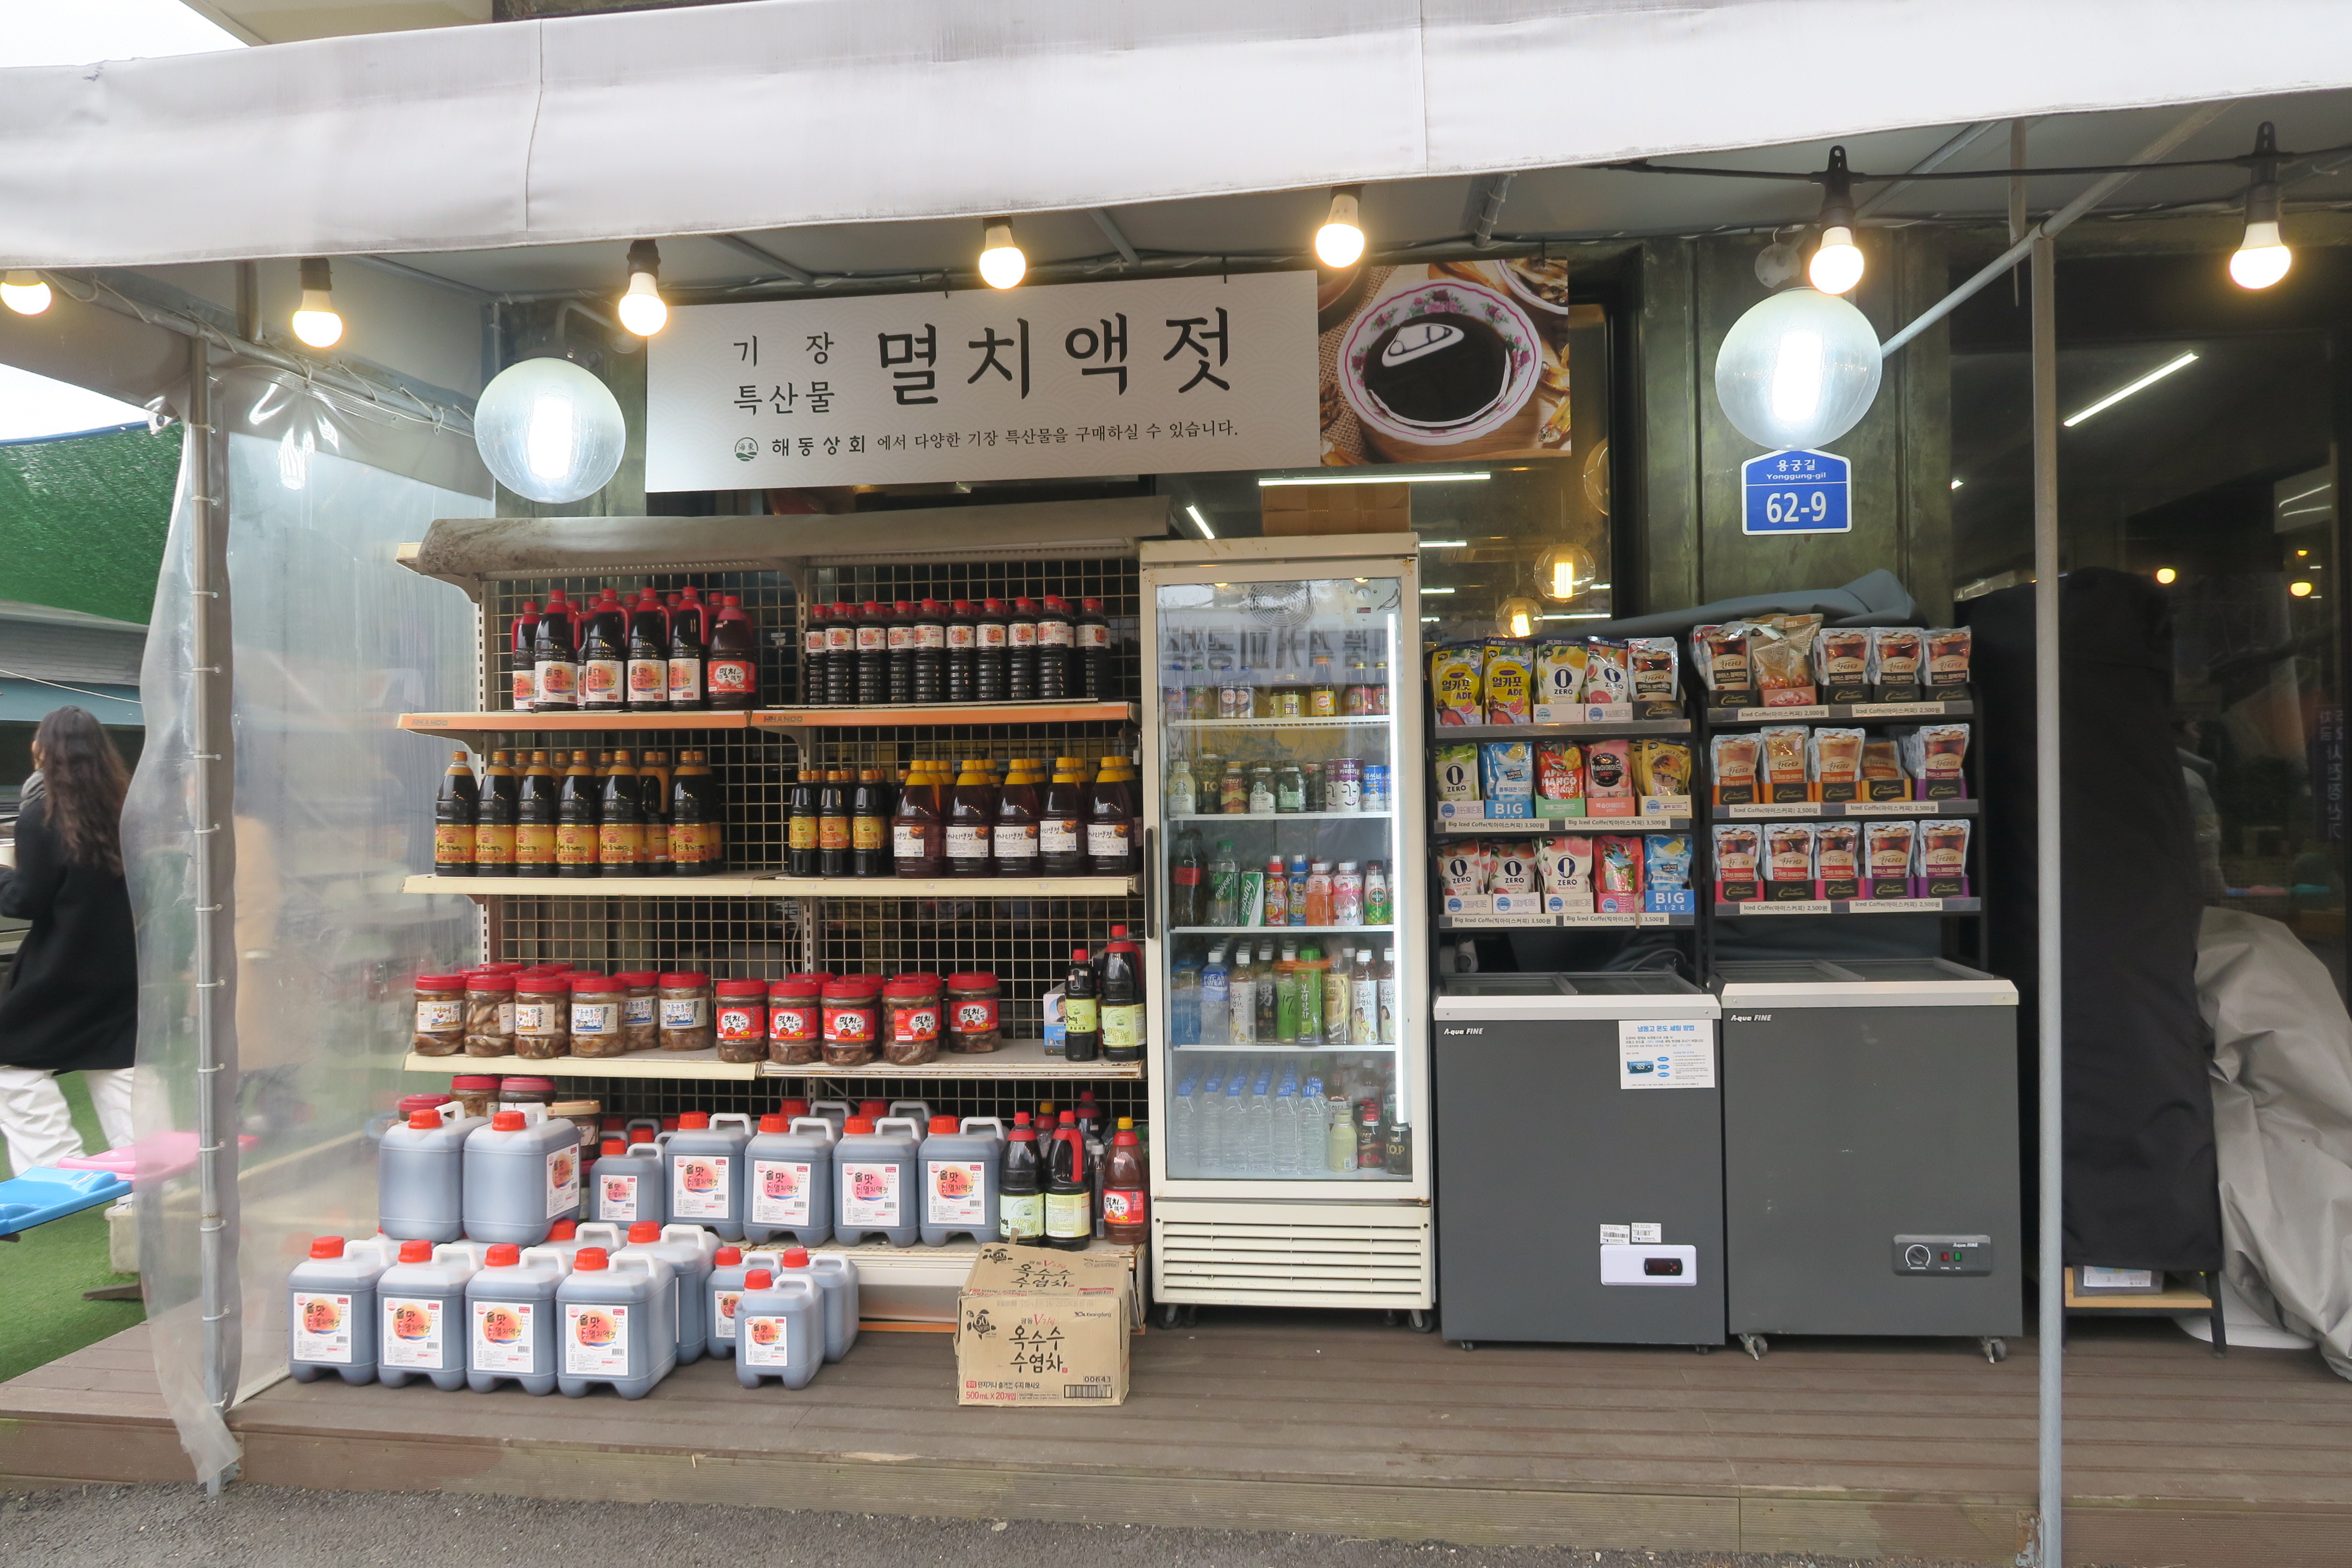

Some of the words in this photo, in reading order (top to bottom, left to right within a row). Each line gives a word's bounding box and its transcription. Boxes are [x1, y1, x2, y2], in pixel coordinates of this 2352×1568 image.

[879, 307, 1232, 406] 멸치액젓
[733, 382, 836, 416] 특산물
[772, 435, 865, 456] 해동상회
[877, 434, 908, 451] 에서
[914, 432, 961, 449] 다양한
[967, 428, 999, 446] 기장
[1004, 426, 1069, 445] 특산물을
[1074, 422, 1139, 444] 구매하실
[1145, 423, 1162, 440] 수
[1169, 419, 1239, 439] 있습니다.
[1777, 459, 1816, 471] 용궁길
[1766, 472, 1826, 480] Yonggung-gil
[1766, 491, 1827, 523] 62-9
[1442, 679, 1471, 691] 얼카포
[1492, 677, 1522, 687] 얼카포
[1650, 751, 1664, 760] BLACK
[1541, 777, 1577, 786] MANGO
[1495, 803, 1523, 814] BIG
[1452, 876, 1472, 884] ZERO
[1655, 892, 1685, 904] BIG
[963, 1008, 980, 1019] 멸치
[725, 1015, 740, 1026] 멸치
[778, 1015, 794, 1026] 멸치
[839, 1016, 857, 1027] 멸치
[915, 1015, 930, 1026] 멸치
[1106, 1197, 1119, 1209] 멸치
[1013, 1264, 1075, 1279] 옥수수
[1011, 1277, 1071, 1288] 수염차
[1008, 1325, 1065, 1352] 옥수수
[1010, 1352, 1063, 1374] 수염차
[996, 1392, 1016, 1400] 20개입
